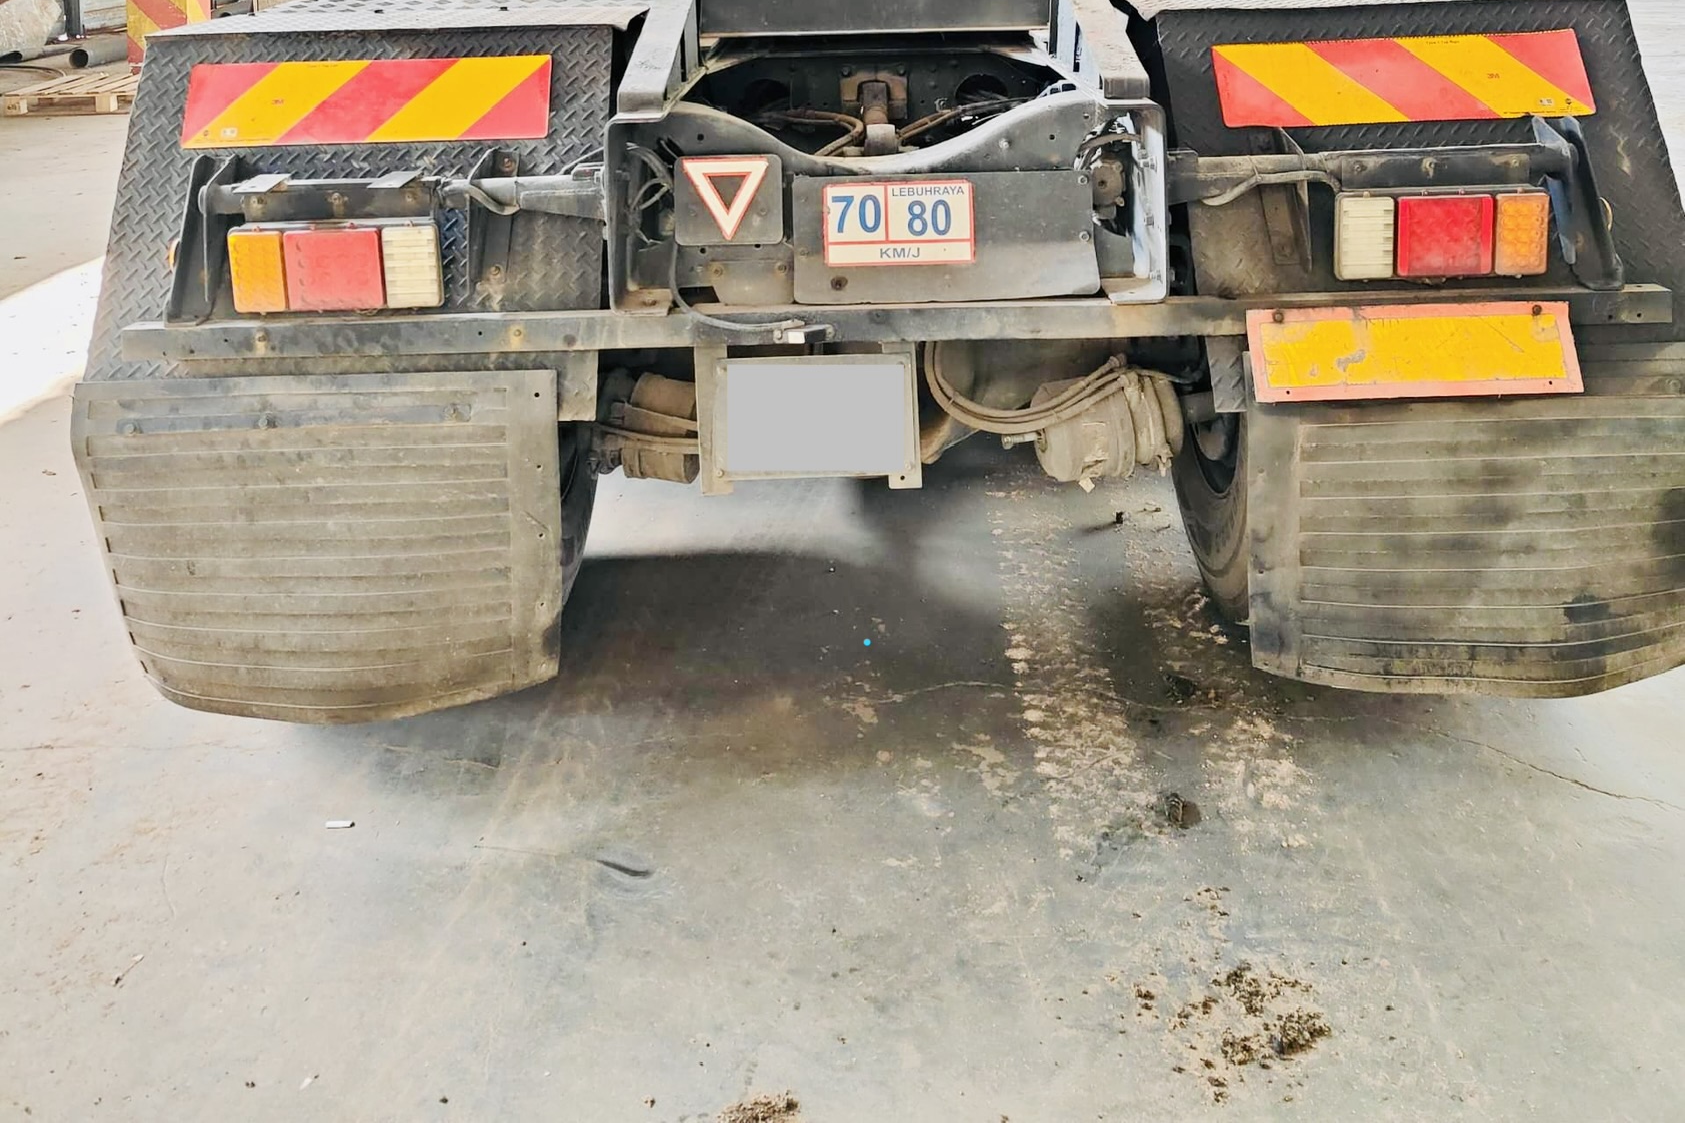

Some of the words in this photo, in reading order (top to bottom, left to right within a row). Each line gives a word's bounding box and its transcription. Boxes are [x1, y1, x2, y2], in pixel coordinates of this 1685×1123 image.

[891, 186, 965, 197] LEBUHRAYA
[831, 194, 882, 234] 70
[907, 199, 952, 237] 80
[879, 247, 921, 259] KM/J
